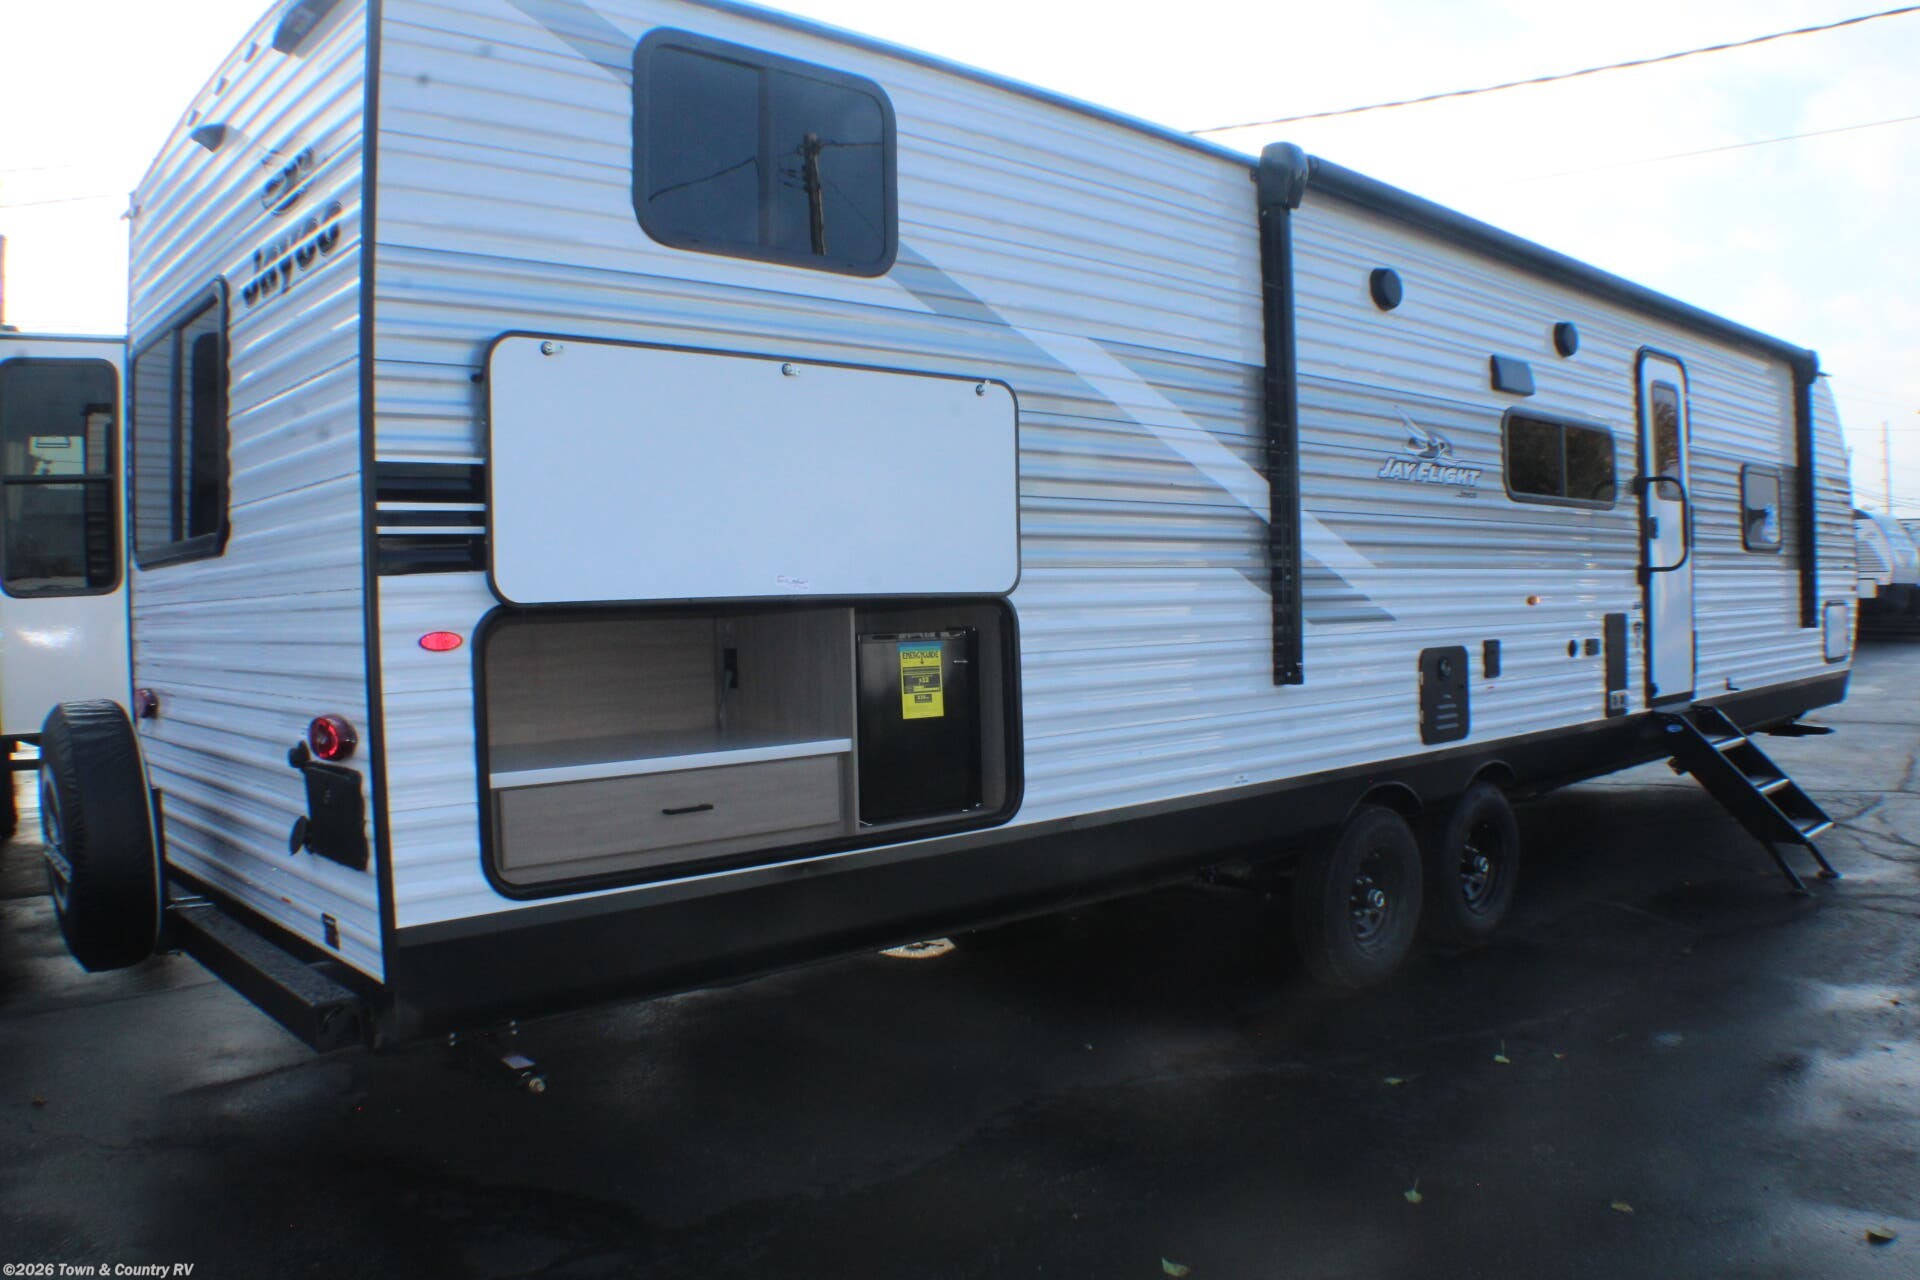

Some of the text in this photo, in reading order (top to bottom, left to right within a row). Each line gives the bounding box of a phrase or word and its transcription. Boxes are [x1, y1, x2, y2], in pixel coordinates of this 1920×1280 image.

[241, 200, 343, 309] Jayco
[1377, 457, 1483, 487] JAY FLIGHT
